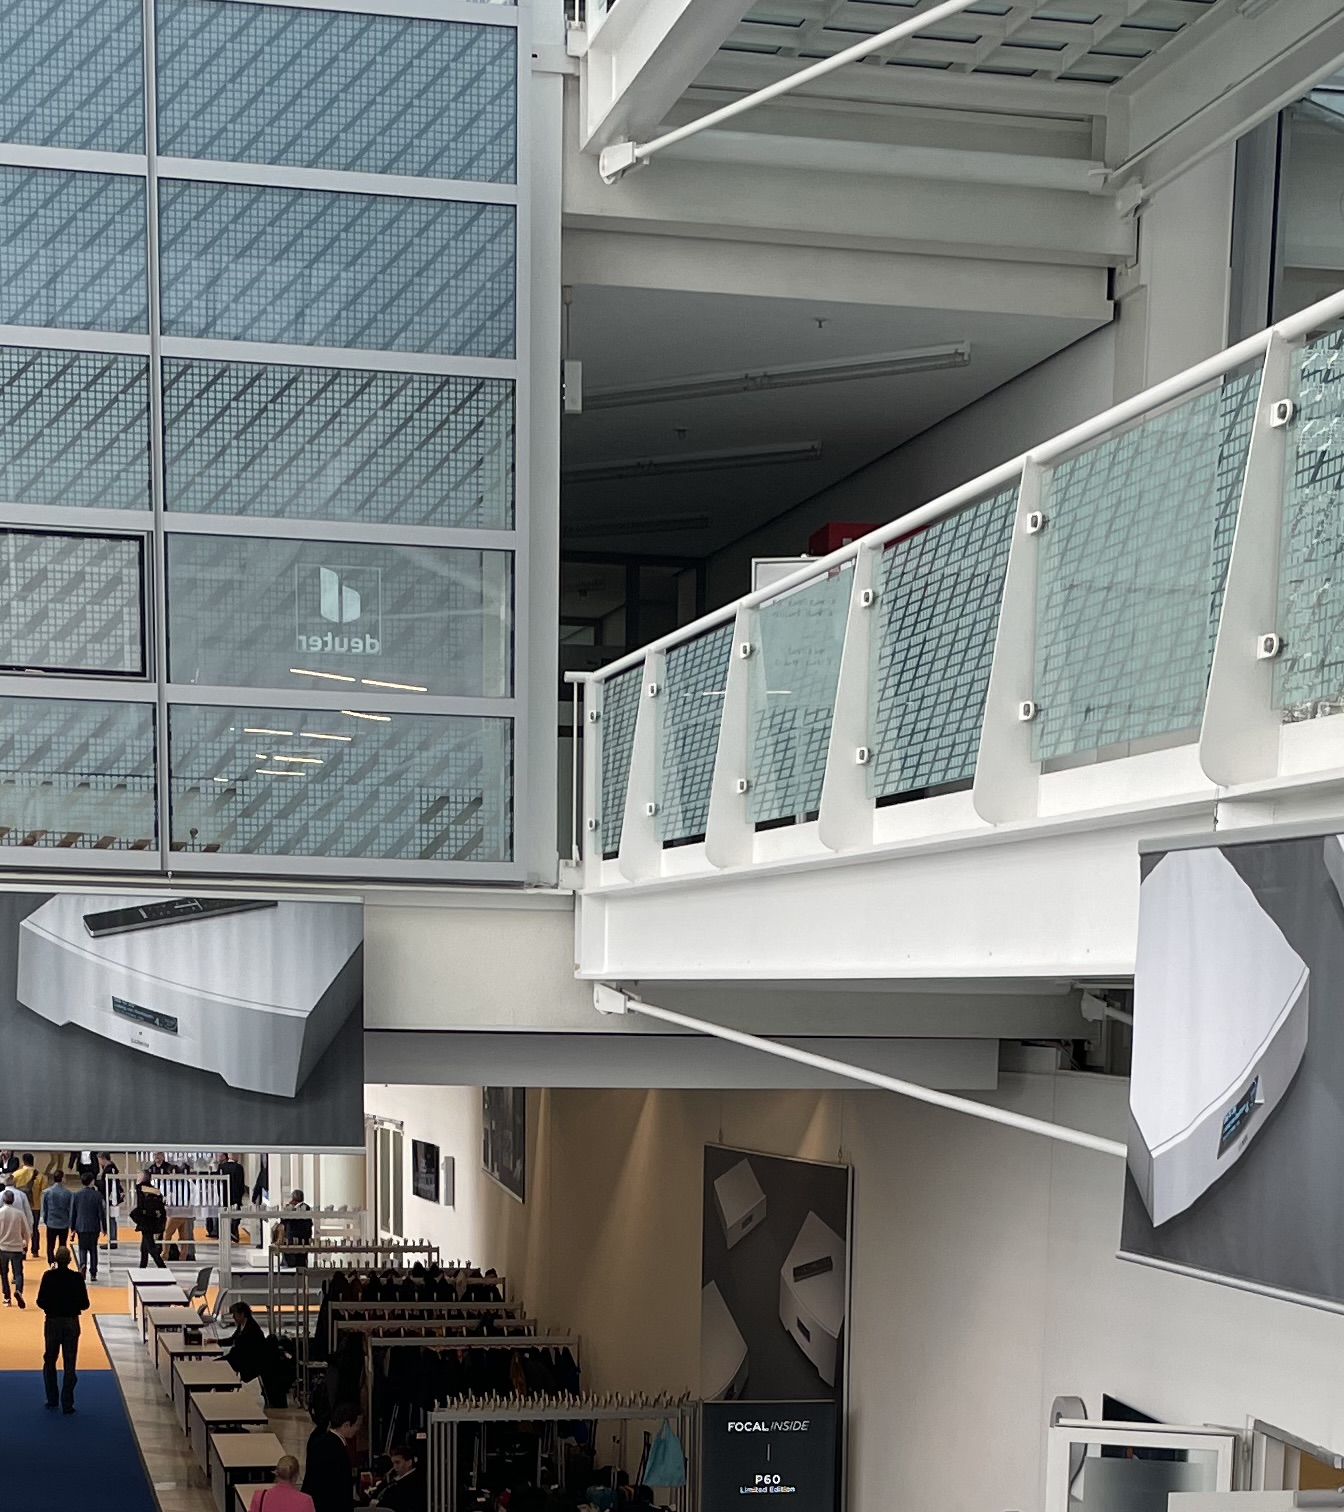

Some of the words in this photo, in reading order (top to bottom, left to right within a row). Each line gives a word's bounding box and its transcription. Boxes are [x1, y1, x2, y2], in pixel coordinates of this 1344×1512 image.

[727, 1421, 769, 1432] FOCAL
[770, 1420, 810, 1431] INSIDE
[755, 1474, 781, 1485] P60
